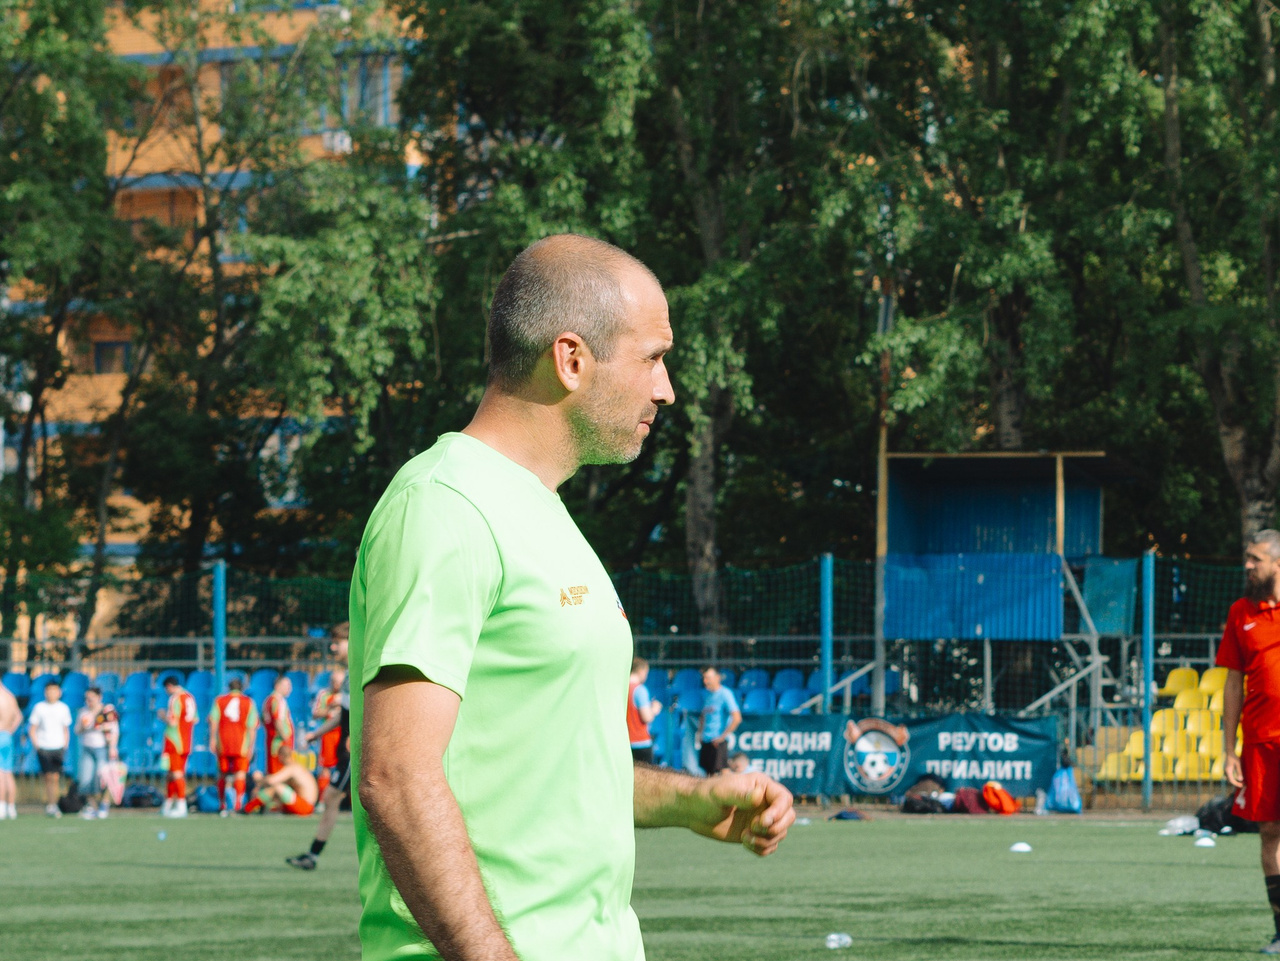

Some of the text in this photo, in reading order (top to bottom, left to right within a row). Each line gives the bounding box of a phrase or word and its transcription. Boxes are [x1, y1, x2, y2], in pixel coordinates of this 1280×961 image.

[738, 731, 832, 755] СЕГОДНЯ
[938, 731, 1019, 752] РЕУТОВ
[751, 758, 816, 781] ЕДИТ?
